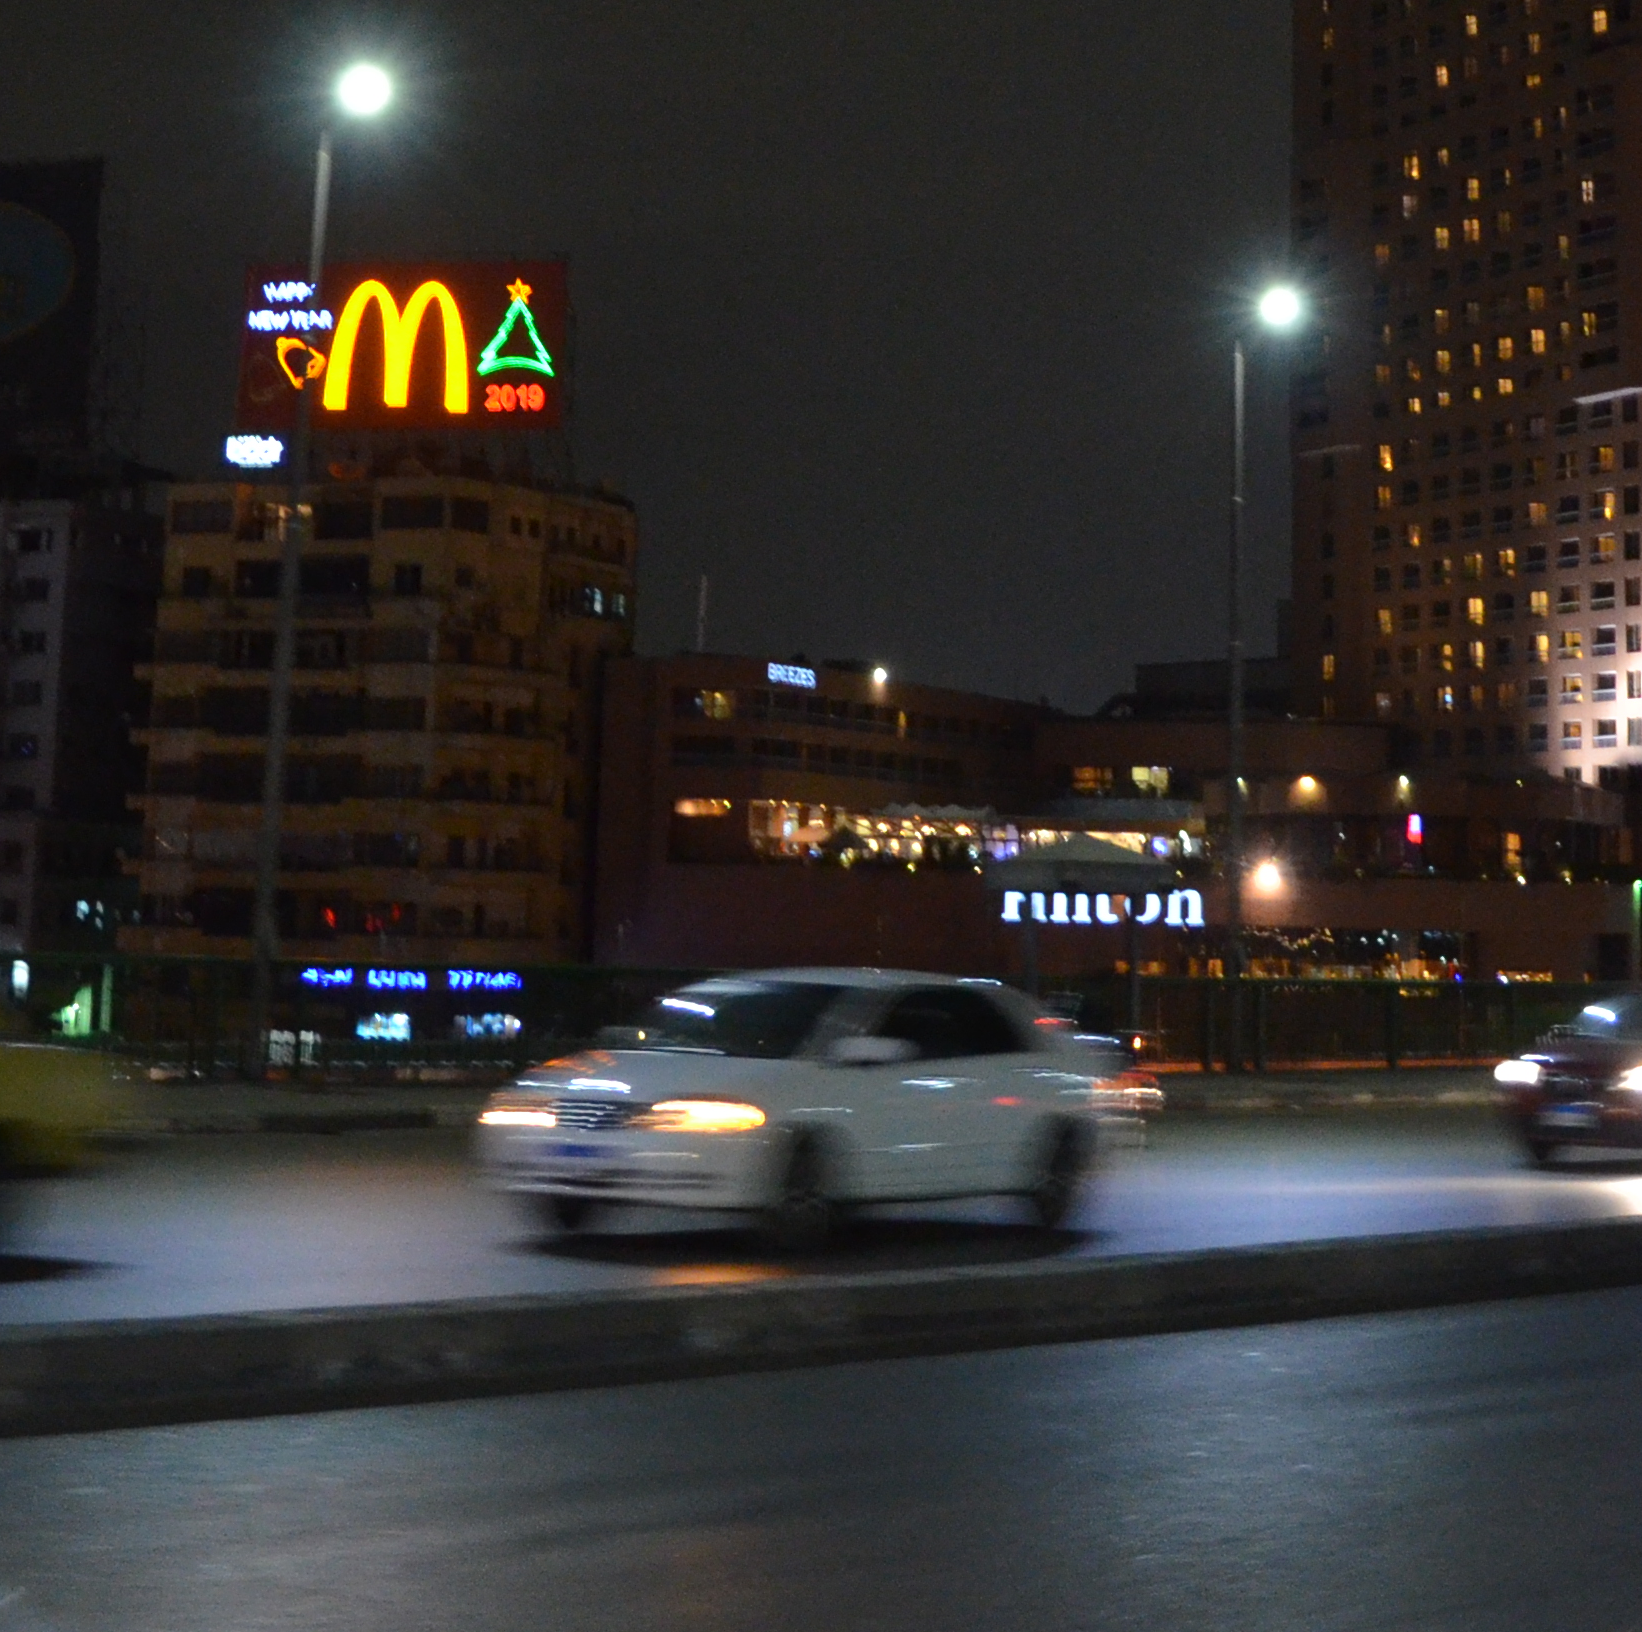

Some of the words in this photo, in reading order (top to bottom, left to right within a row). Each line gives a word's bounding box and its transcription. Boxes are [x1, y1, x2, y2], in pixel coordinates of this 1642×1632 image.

[247, 309, 290, 332] NEW
[484, 383, 546, 412] 2019
[767, 662, 816, 689] BREEZES
